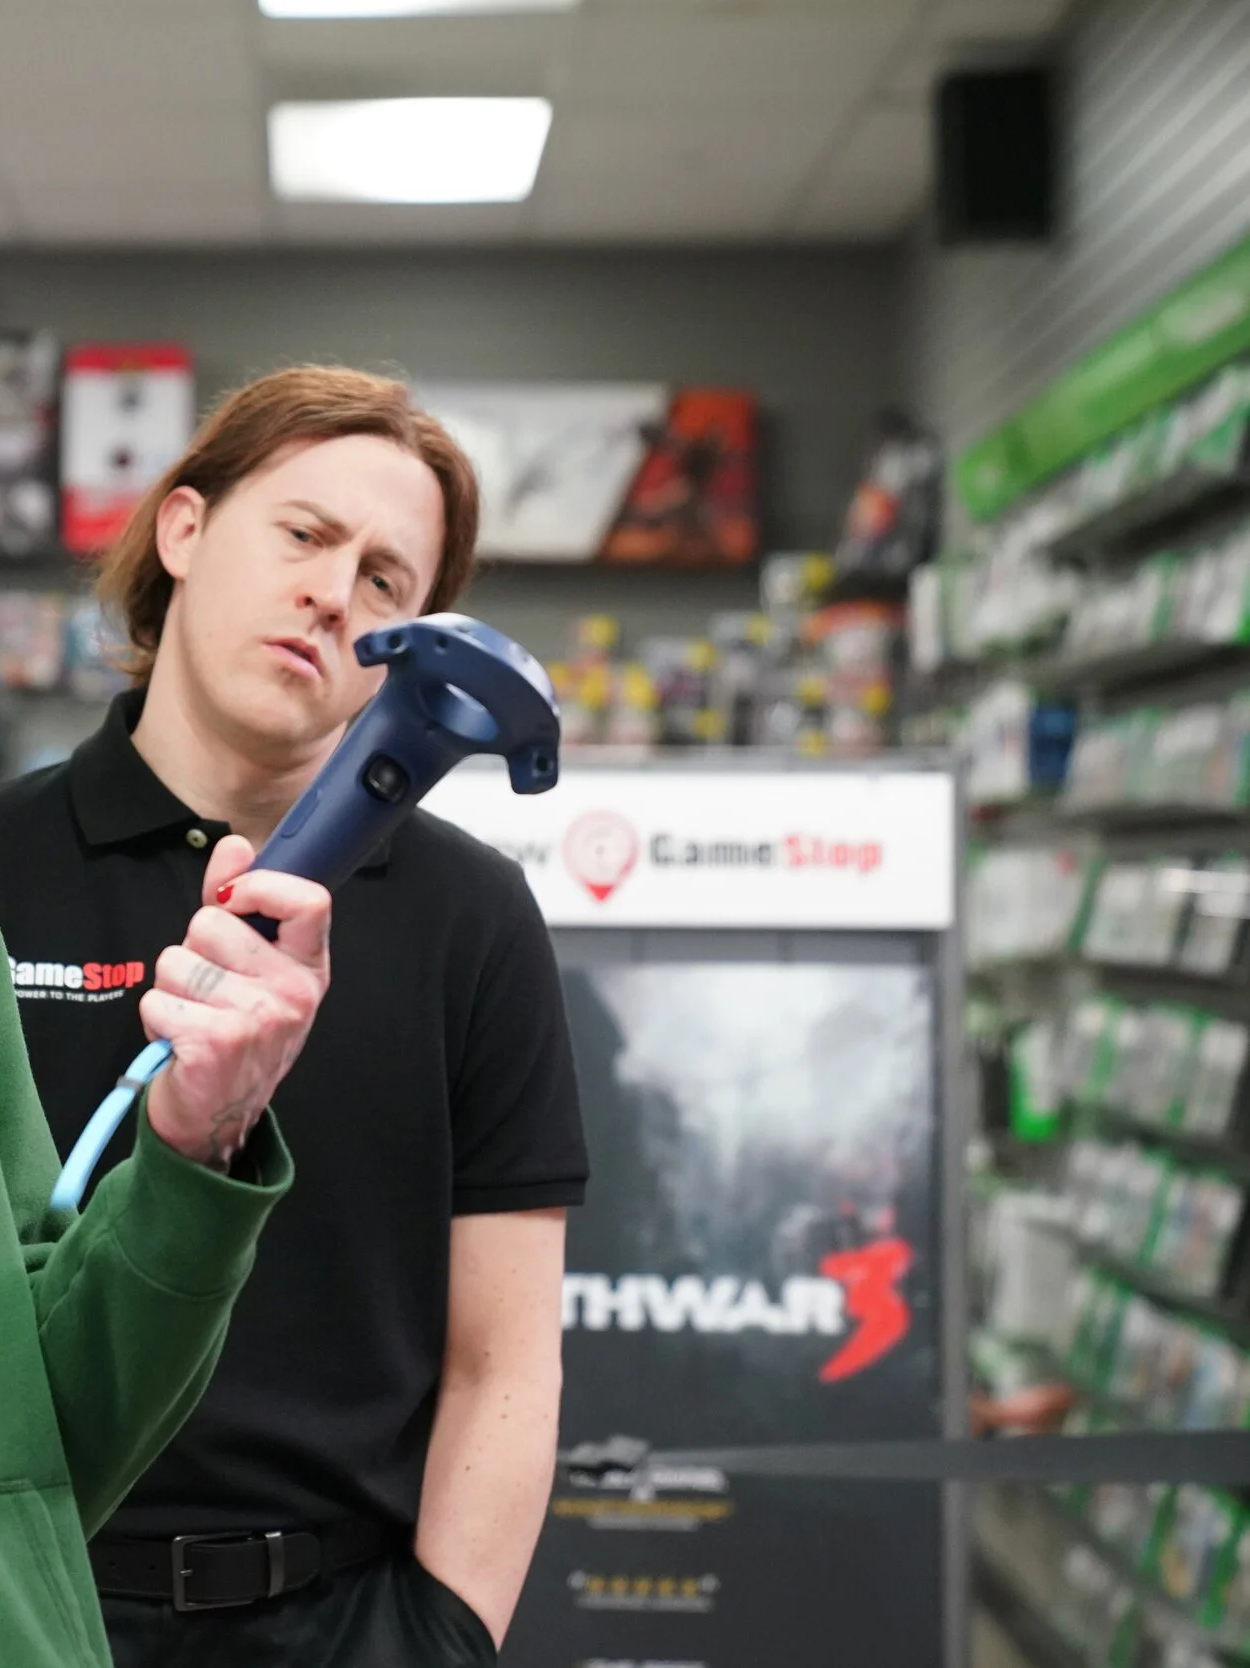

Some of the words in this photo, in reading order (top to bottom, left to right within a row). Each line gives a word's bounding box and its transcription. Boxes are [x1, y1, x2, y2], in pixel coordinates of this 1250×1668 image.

[15, 989, 47, 999] OWER
[50, 991, 64, 1000] TO
[66, 992, 85, 1002] THE
[87, 989, 125, 1003] PLAYERS
